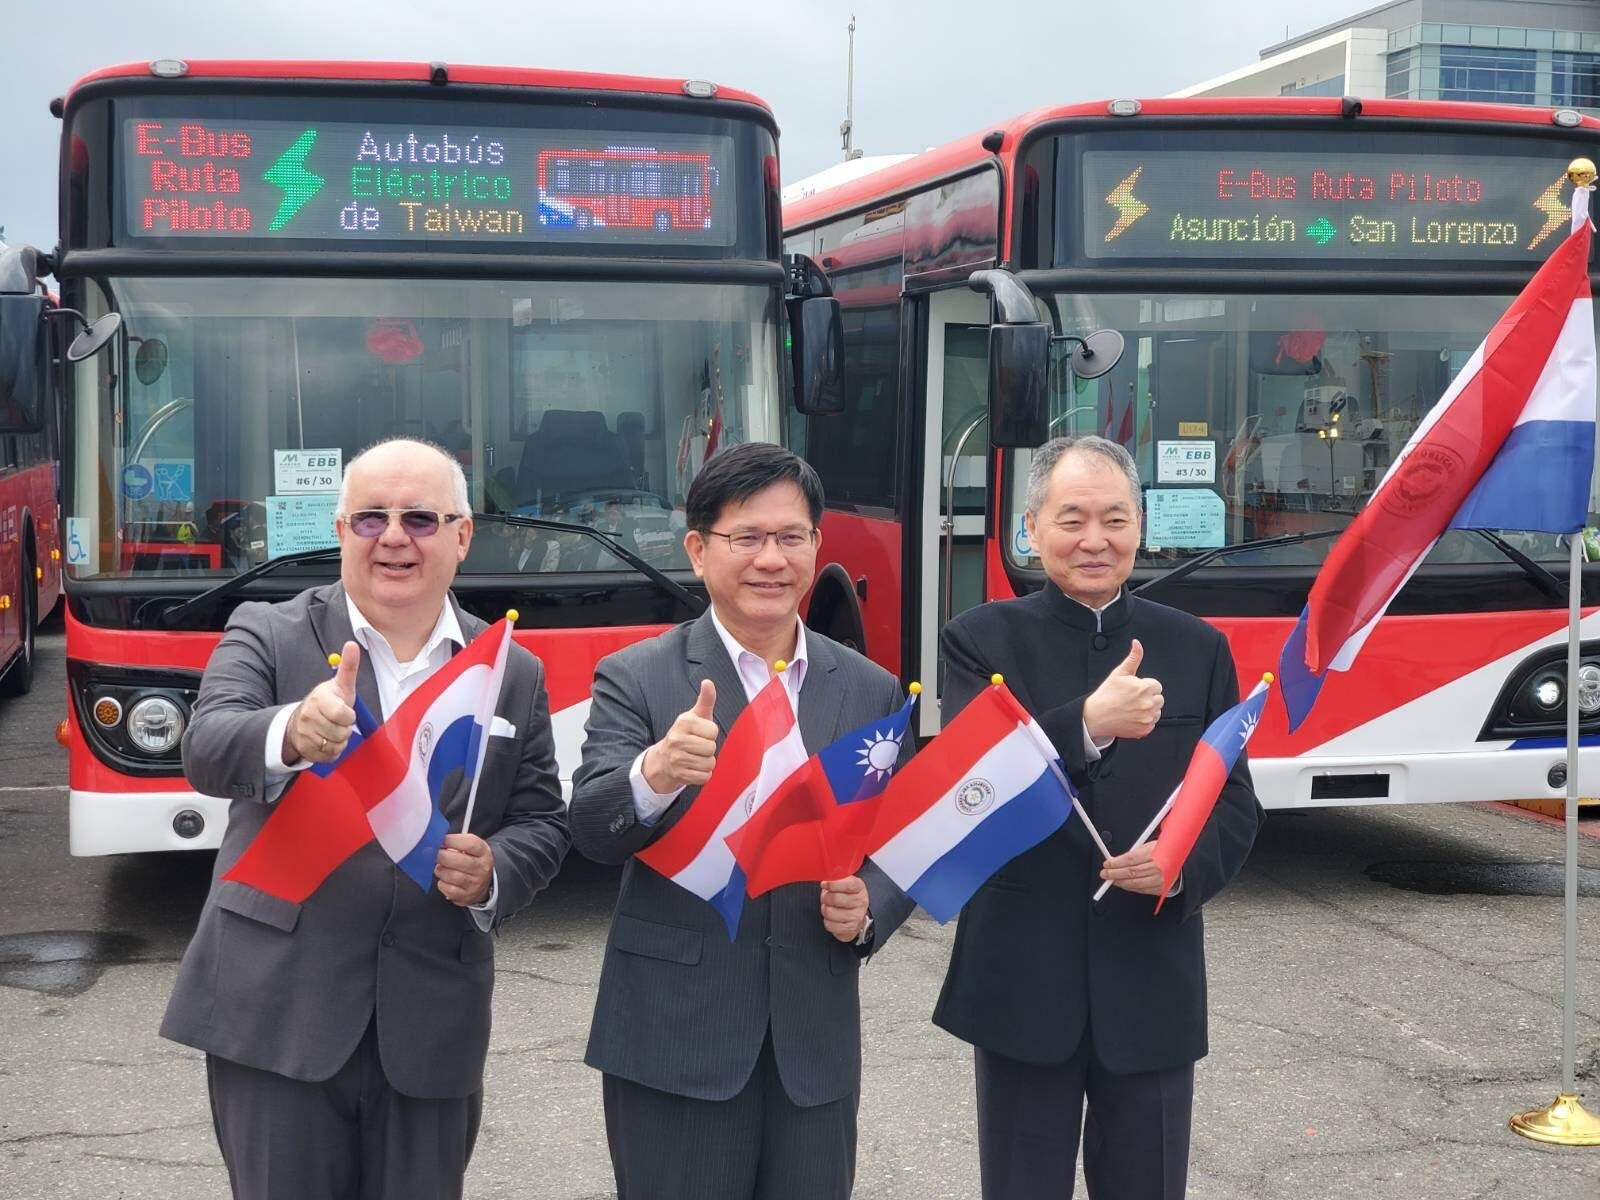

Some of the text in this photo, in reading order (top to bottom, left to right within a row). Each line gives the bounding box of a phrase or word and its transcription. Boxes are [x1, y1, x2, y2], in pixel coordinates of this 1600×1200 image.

[136, 122, 251, 158] E-Bus
[357, 131, 504, 165] Autobús
[152, 160, 240, 192] Ruta
[352, 167, 512, 199] Eléctrico
[1218, 170, 1481, 201] E-Bus Ruta Piloto
[143, 198, 251, 231] Piloto
[340, 201, 523, 233] de Taiwan
[1170, 213, 1517, 245] Asunción San Lorenzo
[307, 457, 337, 467] EBB
[1186, 451, 1211, 460] EBB
